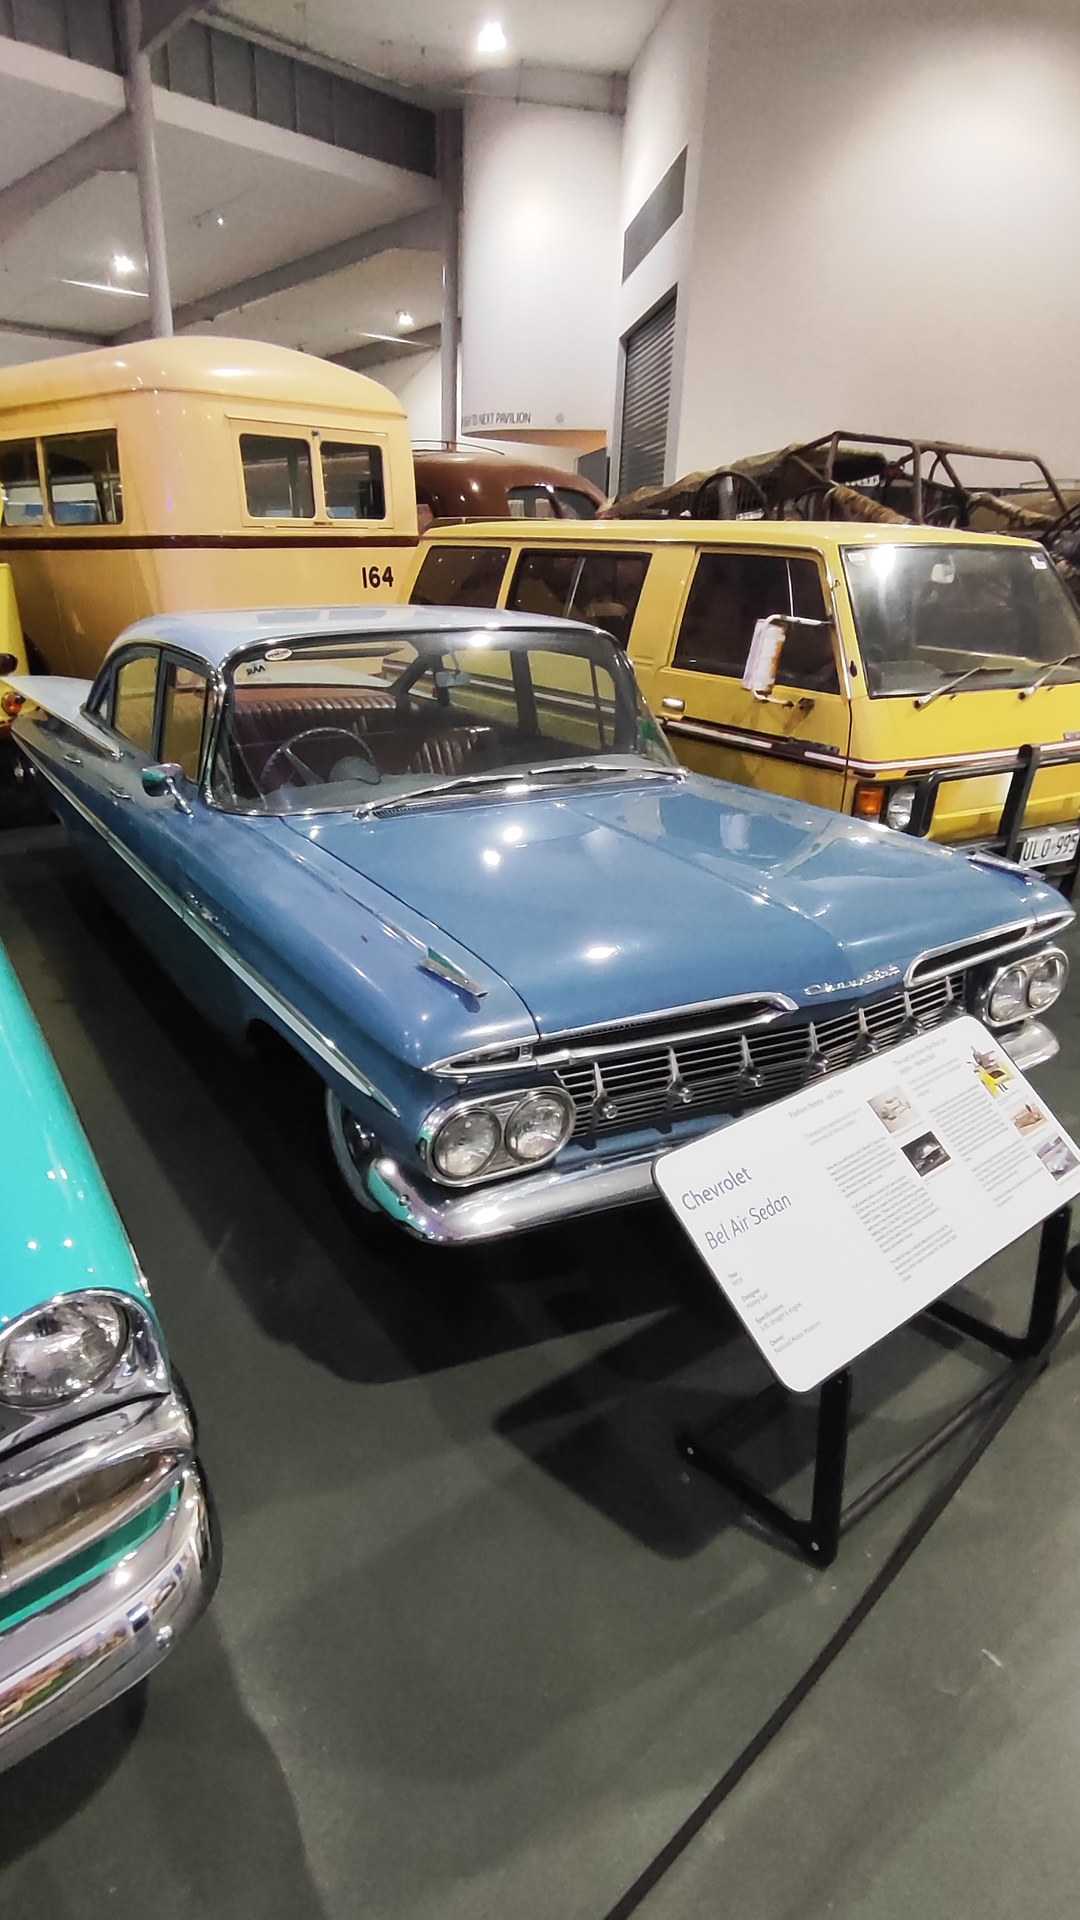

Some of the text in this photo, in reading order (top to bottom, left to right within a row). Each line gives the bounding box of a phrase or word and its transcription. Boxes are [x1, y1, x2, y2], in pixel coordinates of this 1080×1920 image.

[479, 412, 494, 425] NEXT
[496, 412, 531, 424] PAVILION
[362, 566, 394, 589] 164
[681, 1167, 752, 1211] Chevrolet
[704, 1195, 792, 1250] Bel Air Sedan
